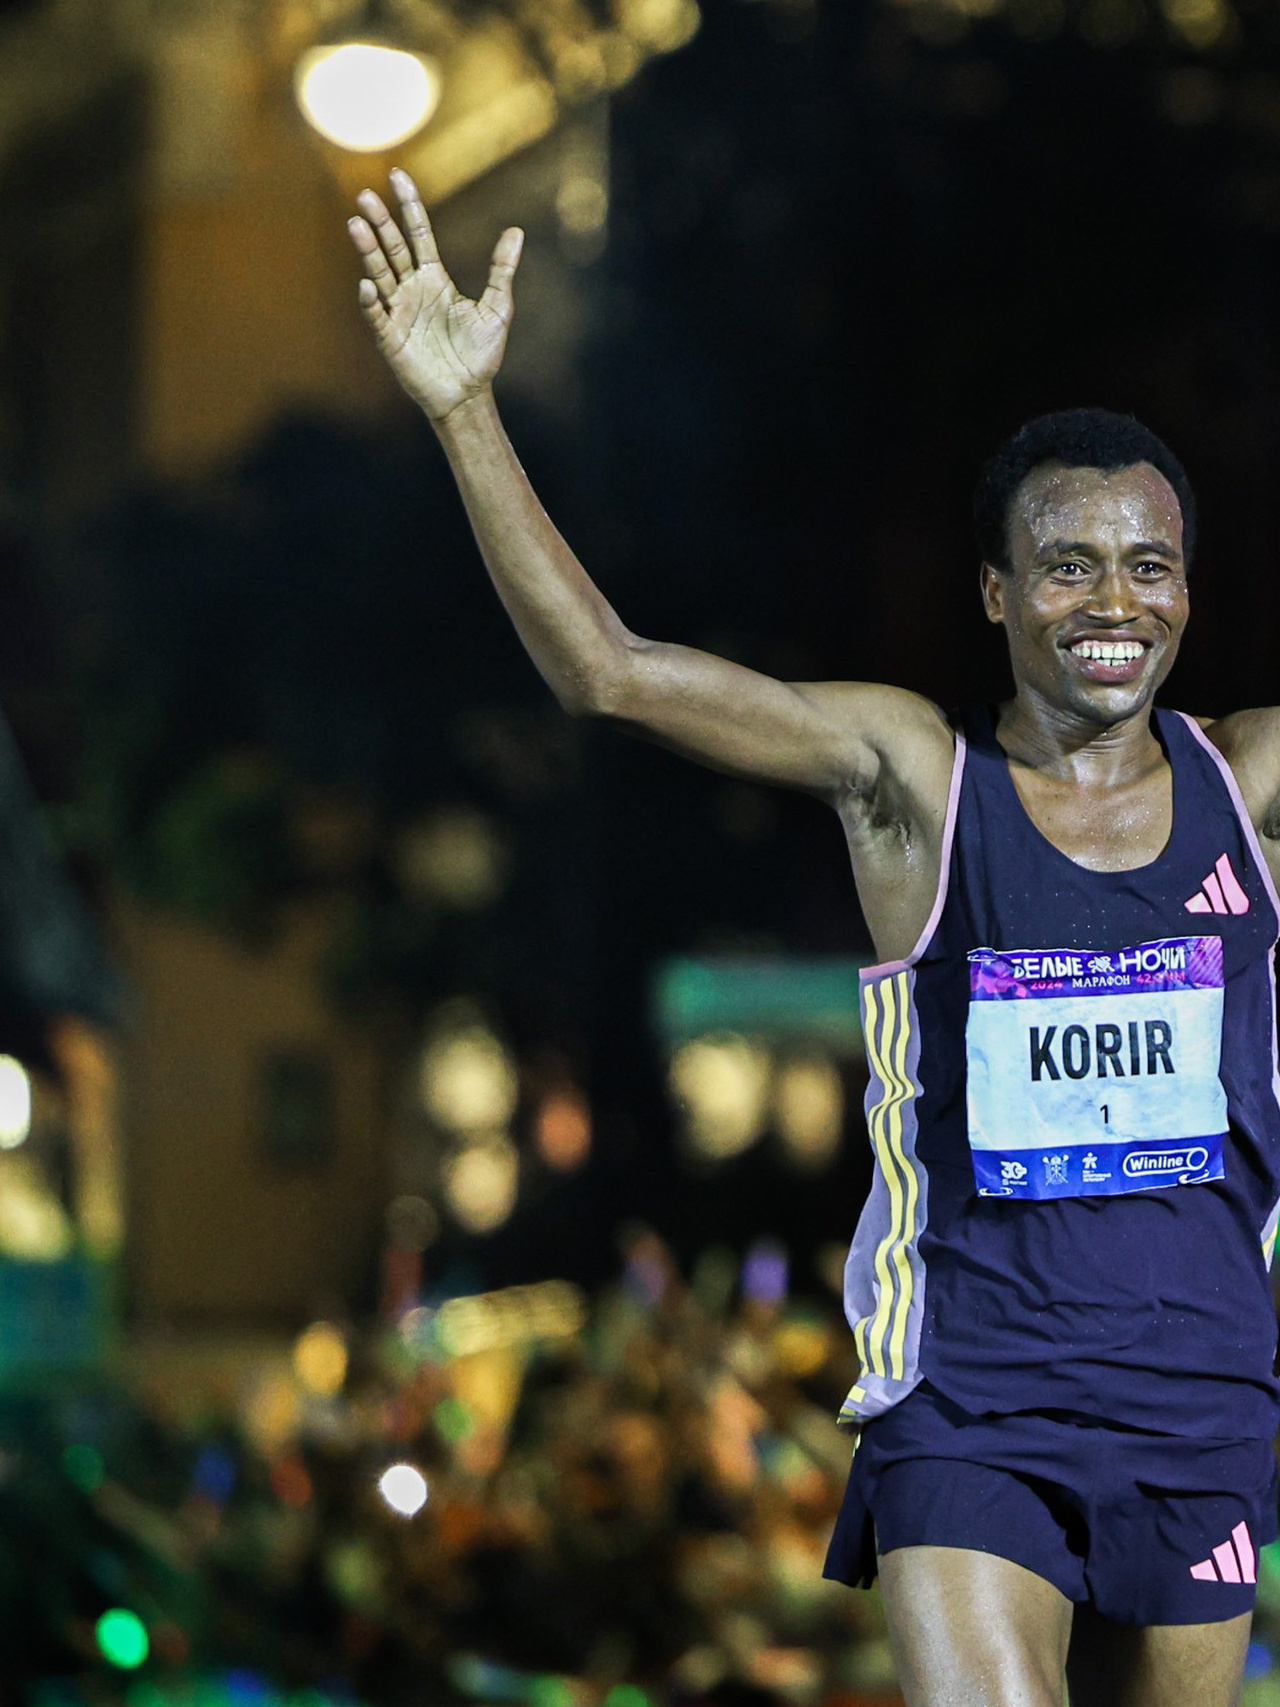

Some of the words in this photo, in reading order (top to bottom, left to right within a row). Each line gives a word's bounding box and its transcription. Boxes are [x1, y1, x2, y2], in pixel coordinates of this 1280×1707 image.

[1011, 956, 1084, 979] БЕЛЫЕ
[1119, 946, 1186, 973] НОЧИ
[1030, 979, 1063, 990] 2024
[1072, 975, 1131, 988] МАРАФОН
[1029, 1020, 1176, 1082] KORIR
[1100, 1104, 1109, 1124] 1
[1130, 1156, 1184, 1171] Winline
